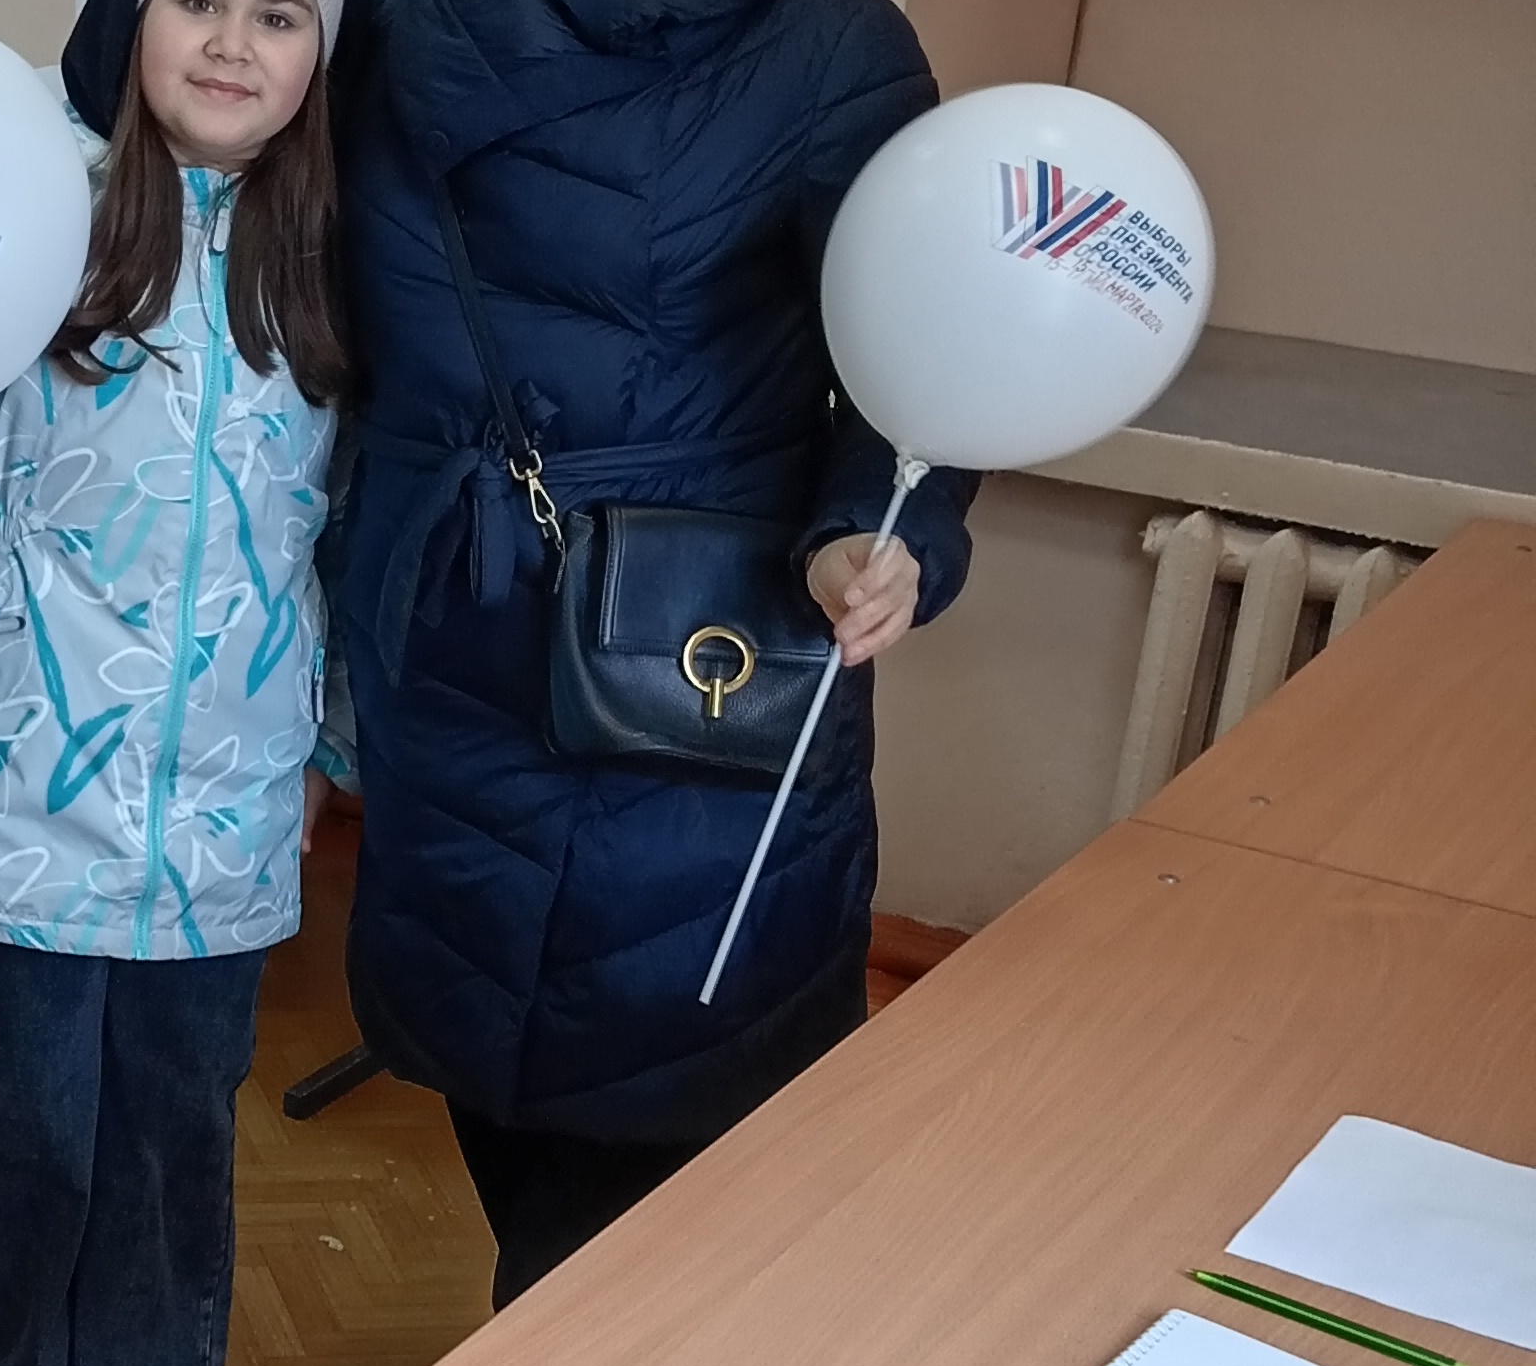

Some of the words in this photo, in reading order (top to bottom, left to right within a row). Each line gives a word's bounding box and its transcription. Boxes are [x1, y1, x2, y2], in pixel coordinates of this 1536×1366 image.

[1092, 241, 1158, 293] РОССИИ
[1112, 225, 1194, 305] ПРЕЗИДЕНТА
[1128, 210, 1193, 268] ВЫБОРЫ
[1106, 280, 1147, 314] МАРТА
[1140, 309, 1165, 335] 2024
